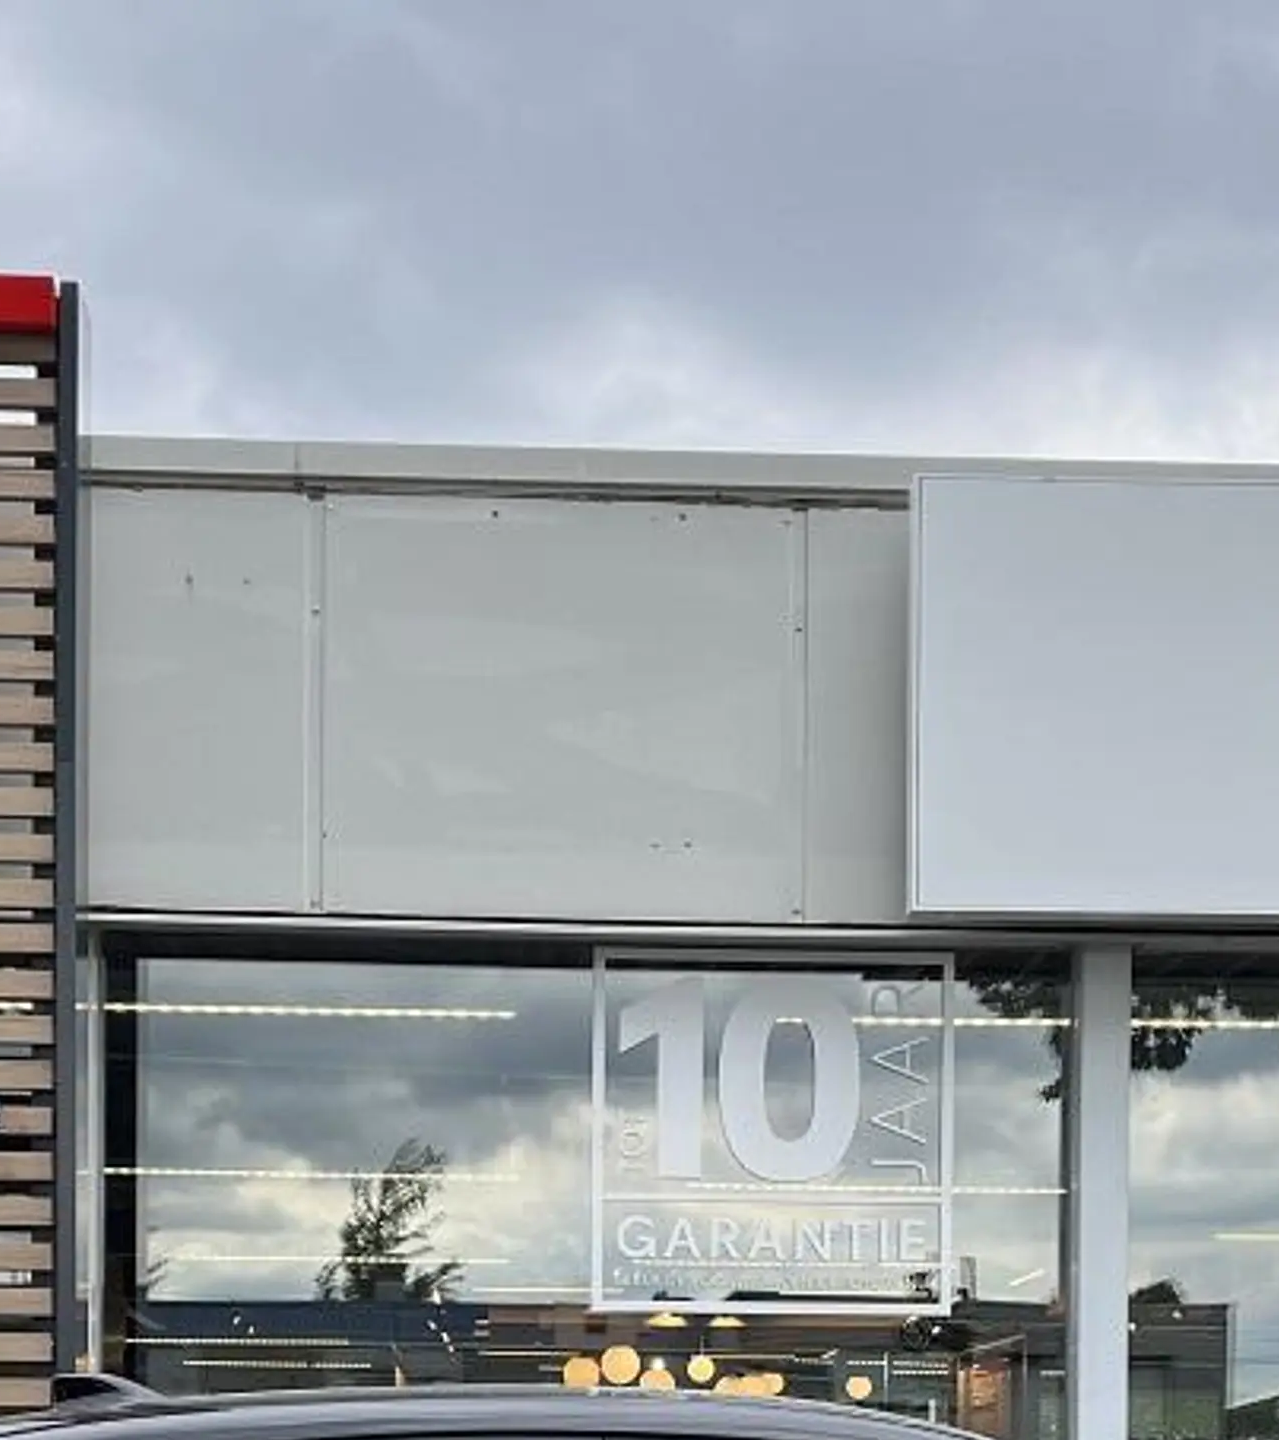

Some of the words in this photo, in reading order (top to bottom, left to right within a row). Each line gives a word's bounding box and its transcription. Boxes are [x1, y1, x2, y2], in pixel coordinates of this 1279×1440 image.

[619, 975, 860, 1183] 10
[870, 977, 930, 1187] JAAR
[615, 1214, 930, 1262] GARANTIE
